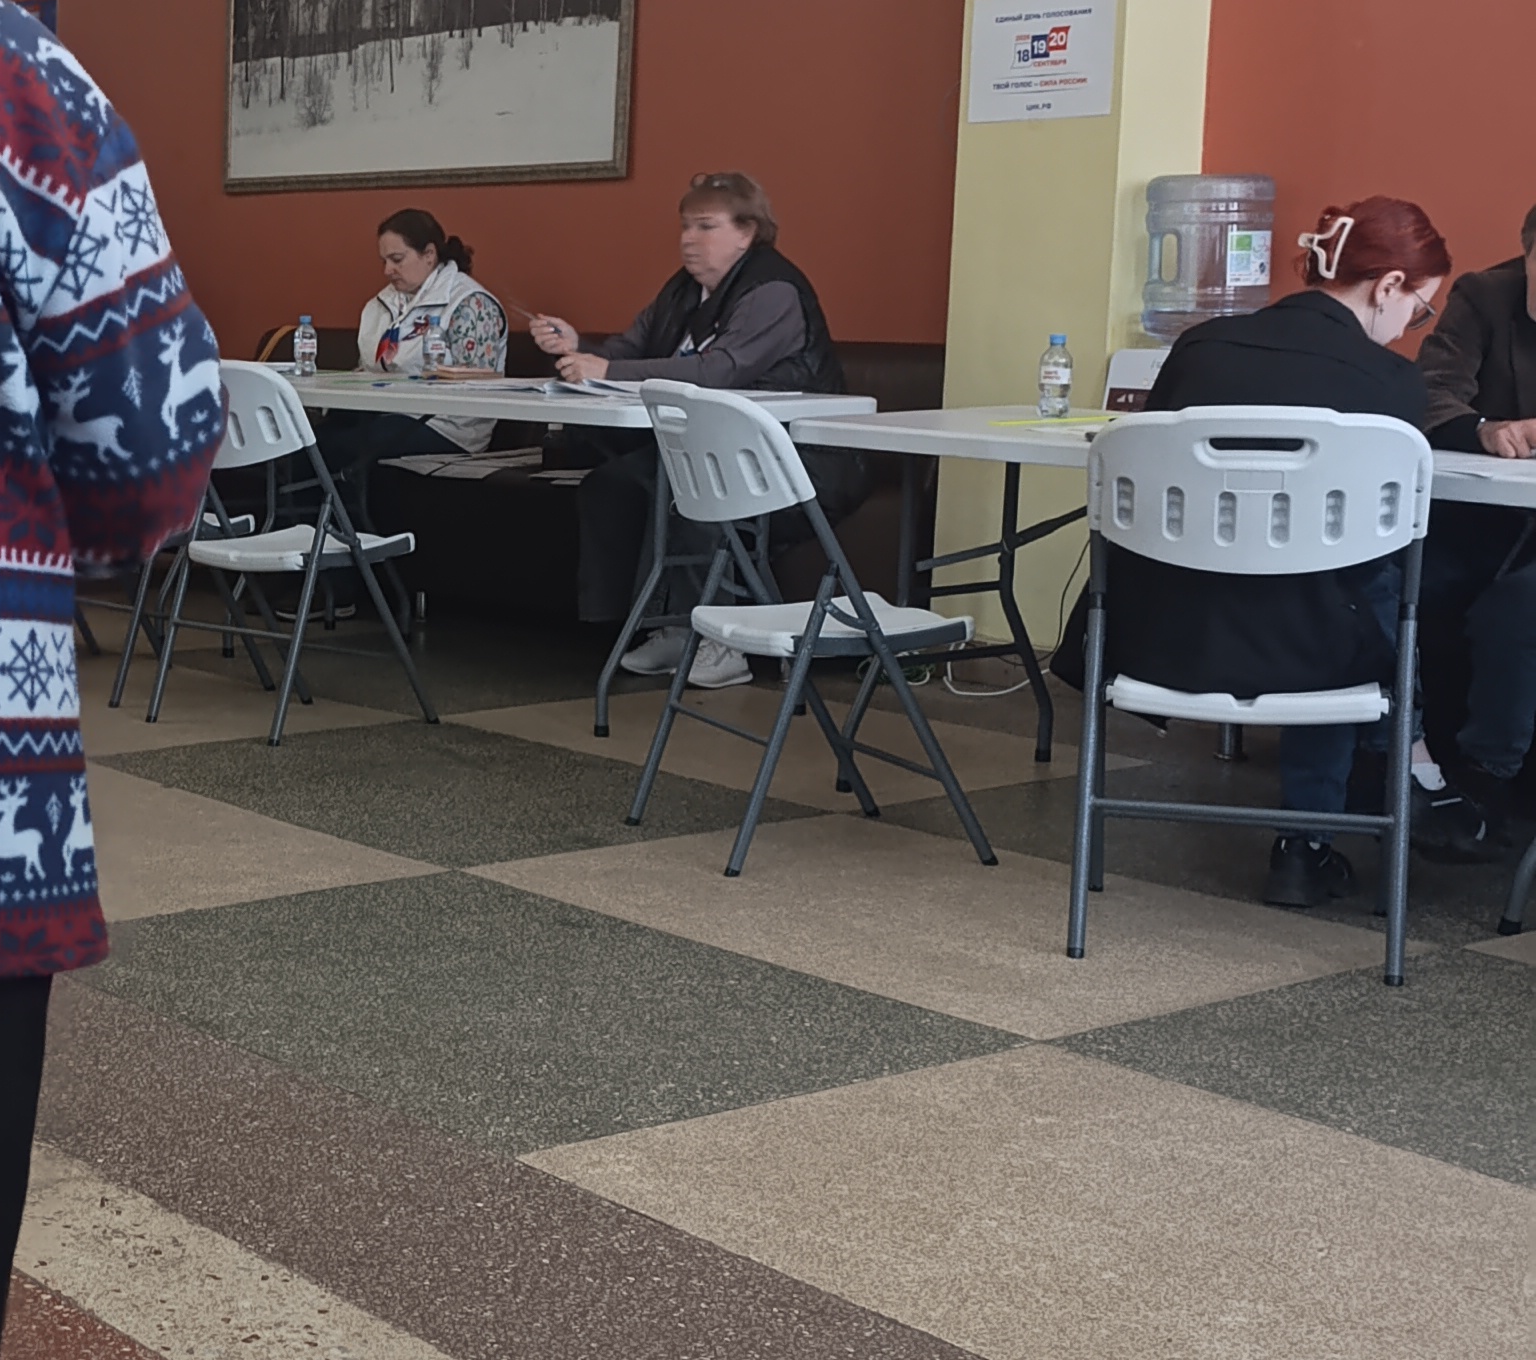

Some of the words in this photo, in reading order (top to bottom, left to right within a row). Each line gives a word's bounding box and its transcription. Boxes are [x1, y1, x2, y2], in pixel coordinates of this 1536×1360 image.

[995, 13, 1023, 24] ЕДИНЫЙ
[1023, 13, 1042, 22] ДЕНЬ
[1042, 7, 1093, 19] ГОЛОСОВАНИЯ
[1016, 49, 1030, 63] 18
[1032, 39, 1047, 55] 19
[1048, 31, 1067, 47] 20
[1032, 58, 1068, 68] СЕНТЯБРЯ
[992, 81, 1010, 91] ТВОЙ
[1010, 81, 1033, 89] ГОЛОС
[1039, 79, 1058, 88] СИЛА
